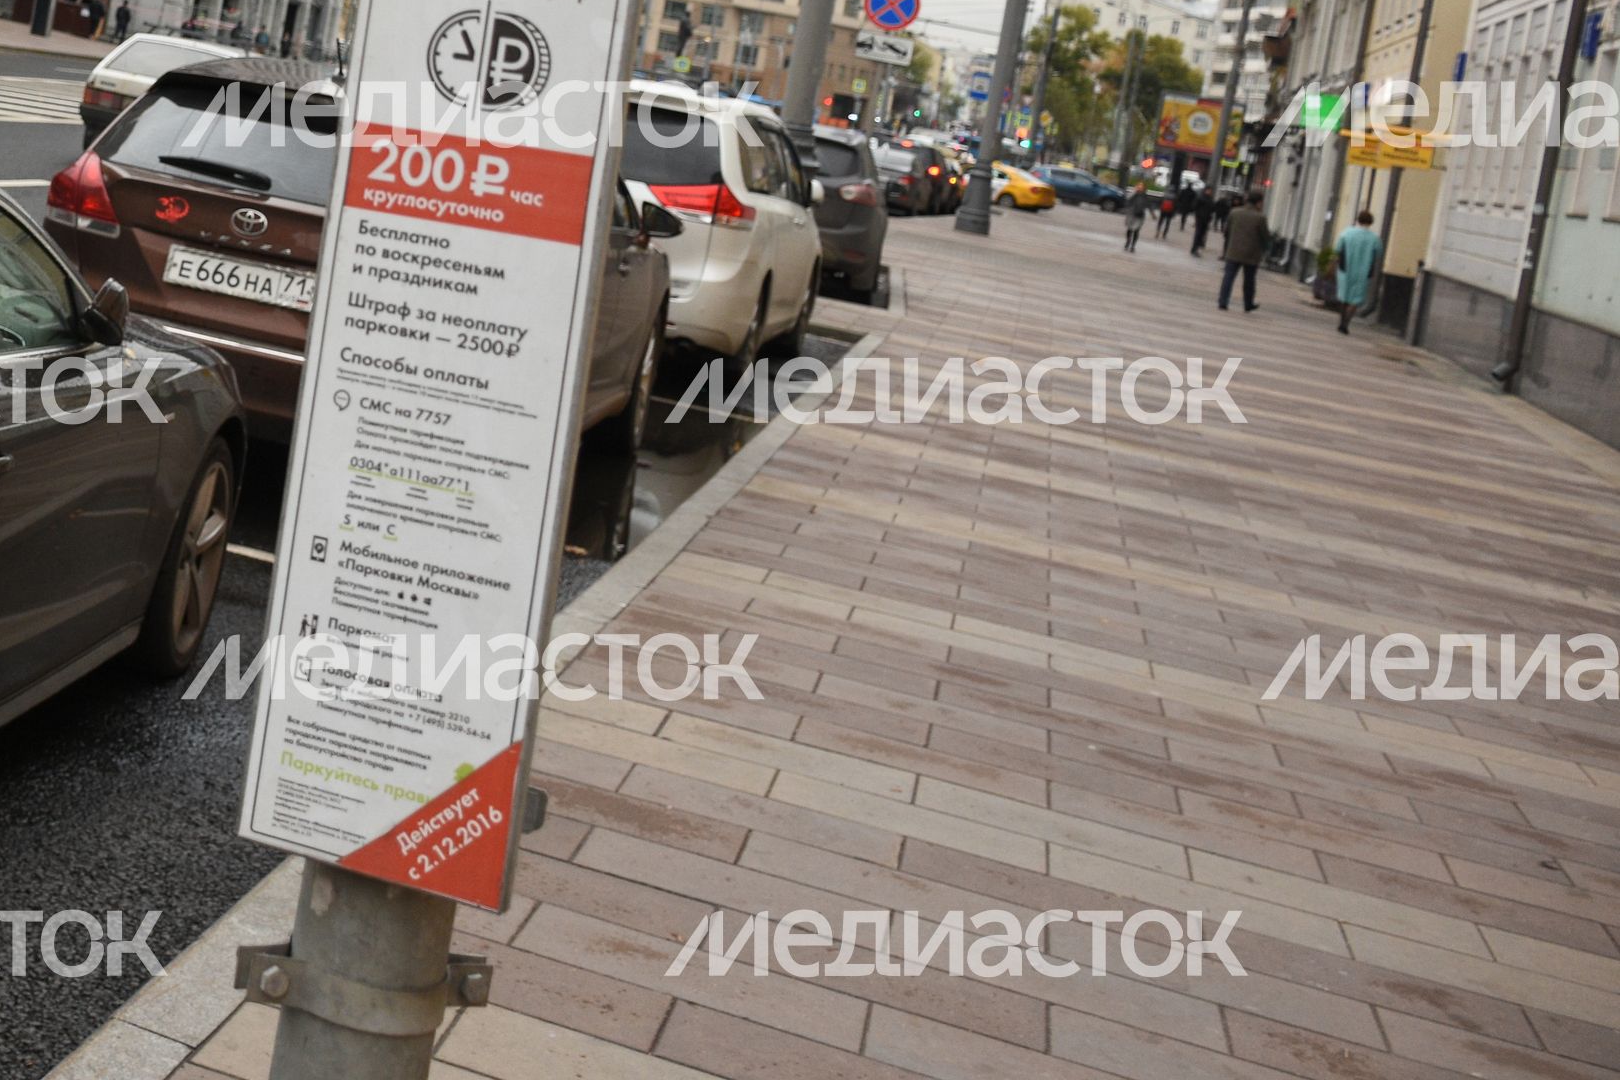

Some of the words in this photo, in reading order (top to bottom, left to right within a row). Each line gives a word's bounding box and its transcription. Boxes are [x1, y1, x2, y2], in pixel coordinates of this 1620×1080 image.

[363, 187, 505, 223] круглосуточно
[510, 192, 544, 208] час
[359, 219, 449, 248] Бесплатно
[355, 241, 378, 257] по
[382, 249, 504, 277] воскресеньям
[352, 264, 362, 273] и
[368, 267, 477, 293] праздникам
[345, 317, 429, 340] парковки
[348, 292, 410, 319] Штраф
[415, 305, 438, 322] за
[442, 315, 526, 341] неоплату
[340, 347, 417, 374] Способы
[423, 368, 488, 388] оплаты
[359, 397, 390, 413] СМС
[392, 404, 413, 419] на
[416, 408, 450, 424] 7757
[342, 513, 352, 527] S
[356, 518, 380, 533] или
[338, 558, 412, 583] «Парковки
[417, 576, 478, 598] Москвы»
[340, 541, 418, 568] Мобильное
[422, 563, 509, 591] приложение
[279, 749, 381, 795] Паркуйтесь
[396, 787, 481, 857] Действует
[408, 865, 421, 881] с
[416, 806, 504, 873] 2.12.2016
